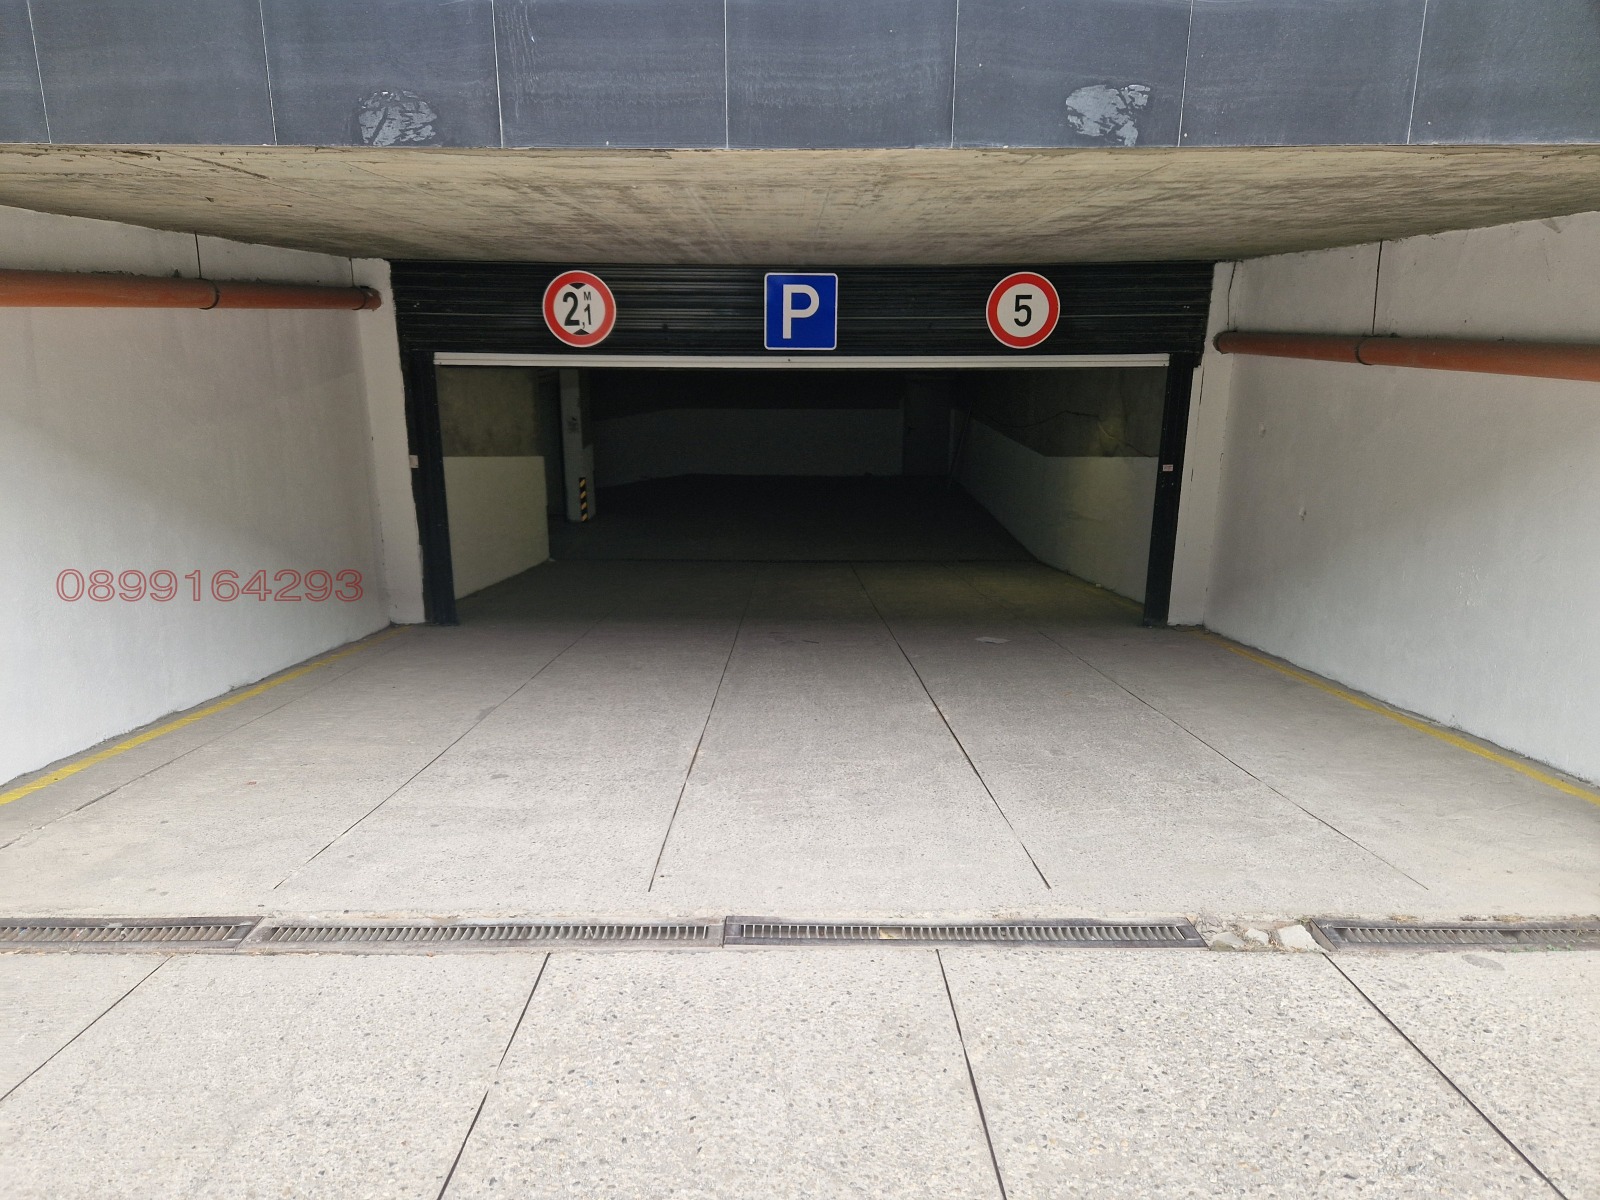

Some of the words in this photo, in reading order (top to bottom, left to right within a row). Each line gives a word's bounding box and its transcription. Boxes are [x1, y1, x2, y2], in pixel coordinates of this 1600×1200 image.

[562, 291, 592, 329] 2,1
[782, 284, 820, 340] P
[1013, 294, 1033, 328] 5
